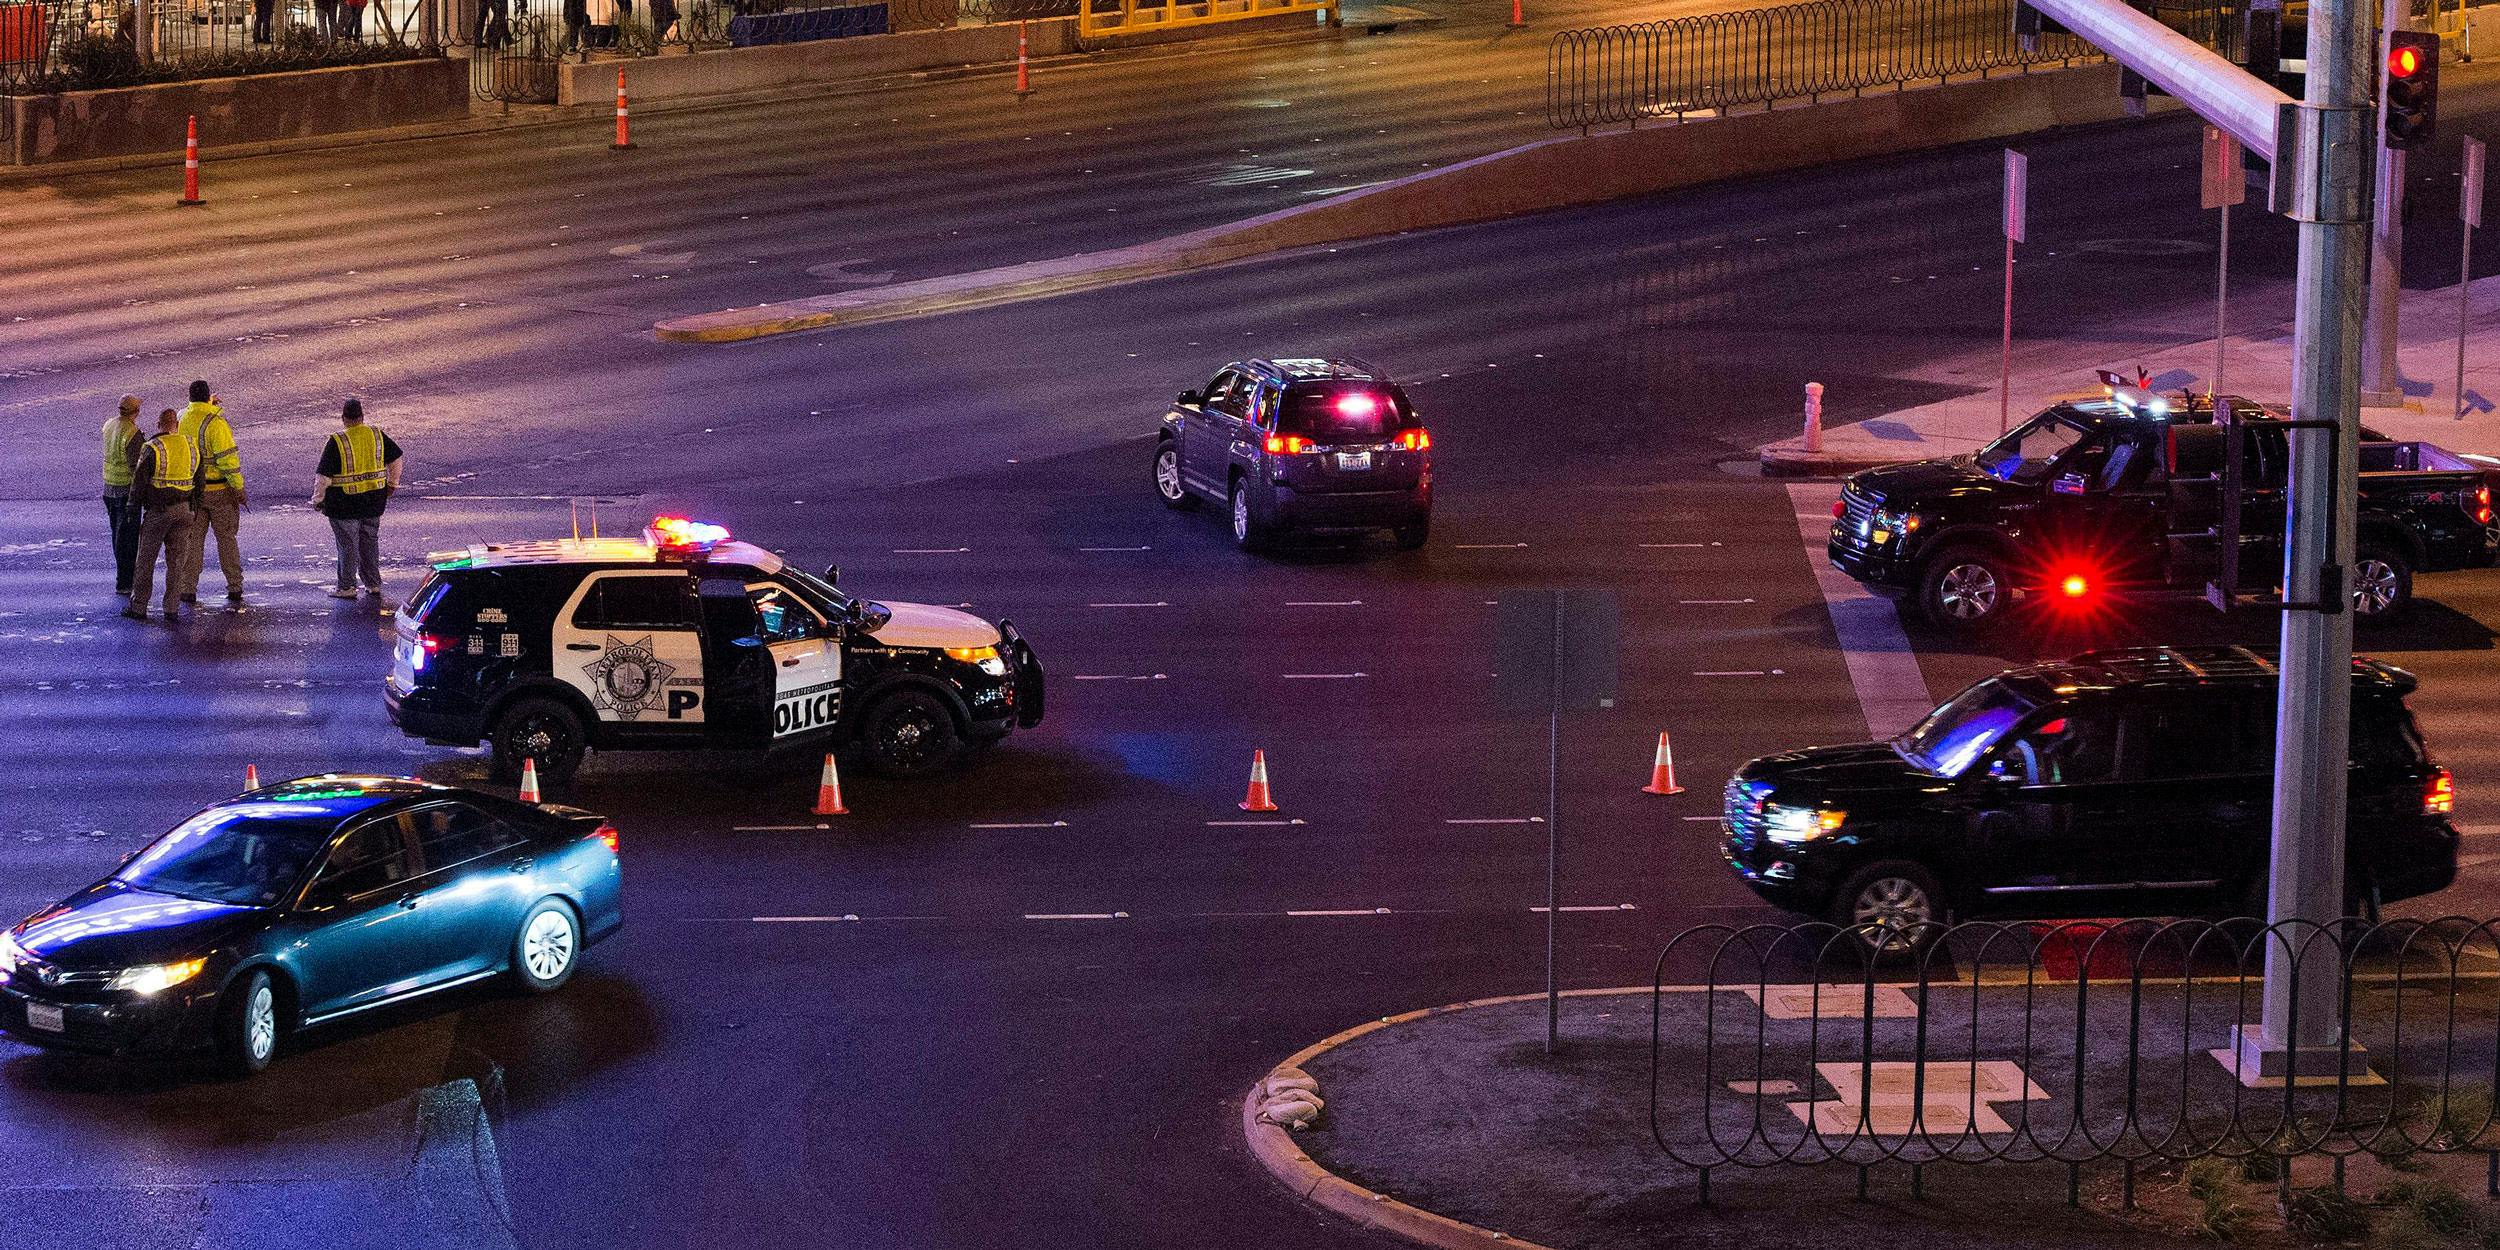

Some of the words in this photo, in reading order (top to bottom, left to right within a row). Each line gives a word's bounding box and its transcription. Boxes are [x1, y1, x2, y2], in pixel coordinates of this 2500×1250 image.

[897, 647, 930, 656] Community
[598, 647, 660, 680] METROPOLITAN
[610, 698, 648, 711] POLICE
